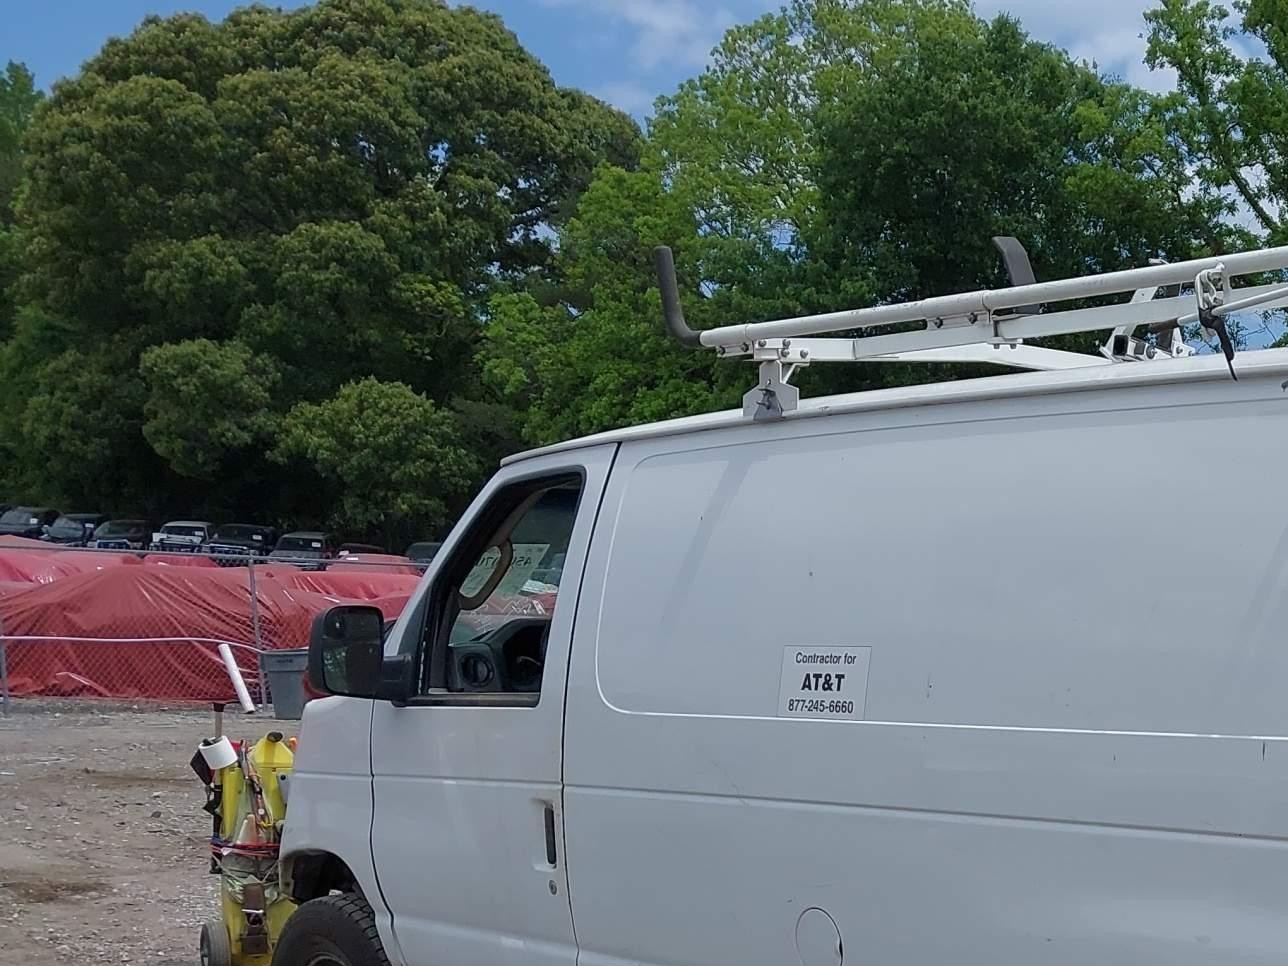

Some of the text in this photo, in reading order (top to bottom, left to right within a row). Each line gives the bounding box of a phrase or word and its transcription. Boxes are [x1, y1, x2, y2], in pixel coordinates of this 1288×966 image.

[795, 652, 857, 665] Contractor for
[800, 672, 846, 692] AT&T
[788, 698, 854, 714] 877-245-6660
